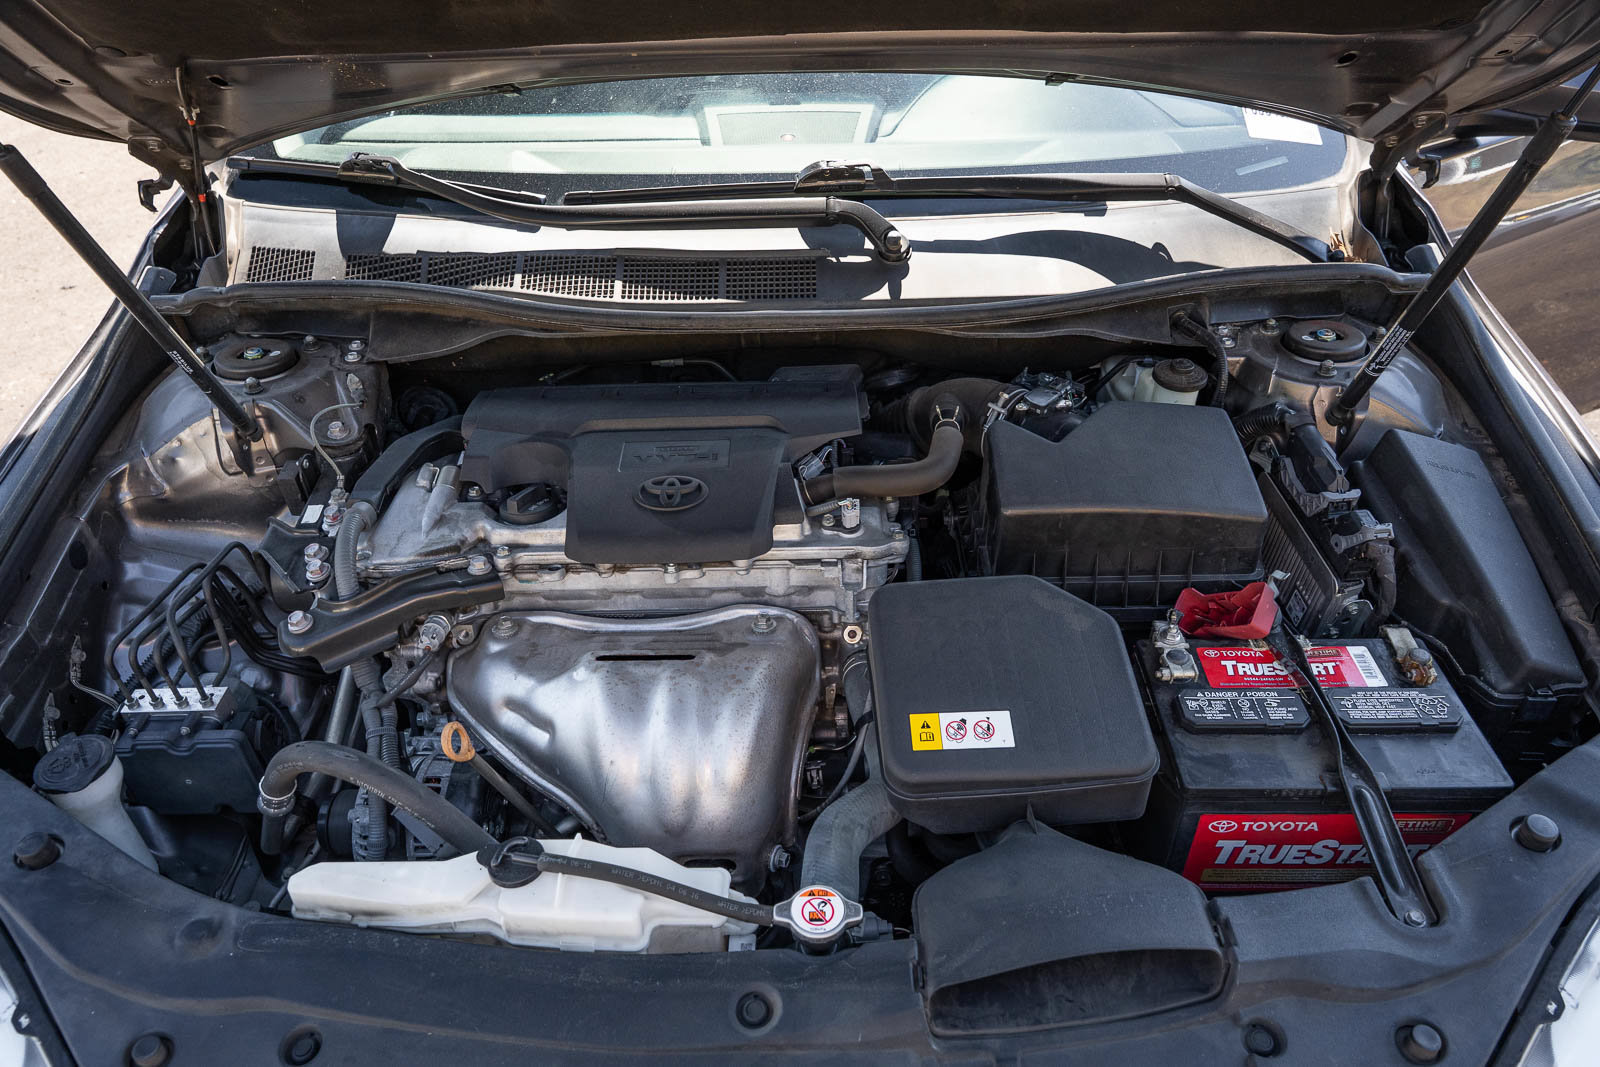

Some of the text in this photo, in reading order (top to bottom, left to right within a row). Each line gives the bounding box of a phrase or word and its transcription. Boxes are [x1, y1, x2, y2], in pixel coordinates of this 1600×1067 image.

[1220, 650, 1264, 658] TOYOTA
[1221, 660, 1336, 676] TRUESRT
[1241, 821, 1319, 832] TOYOTA
